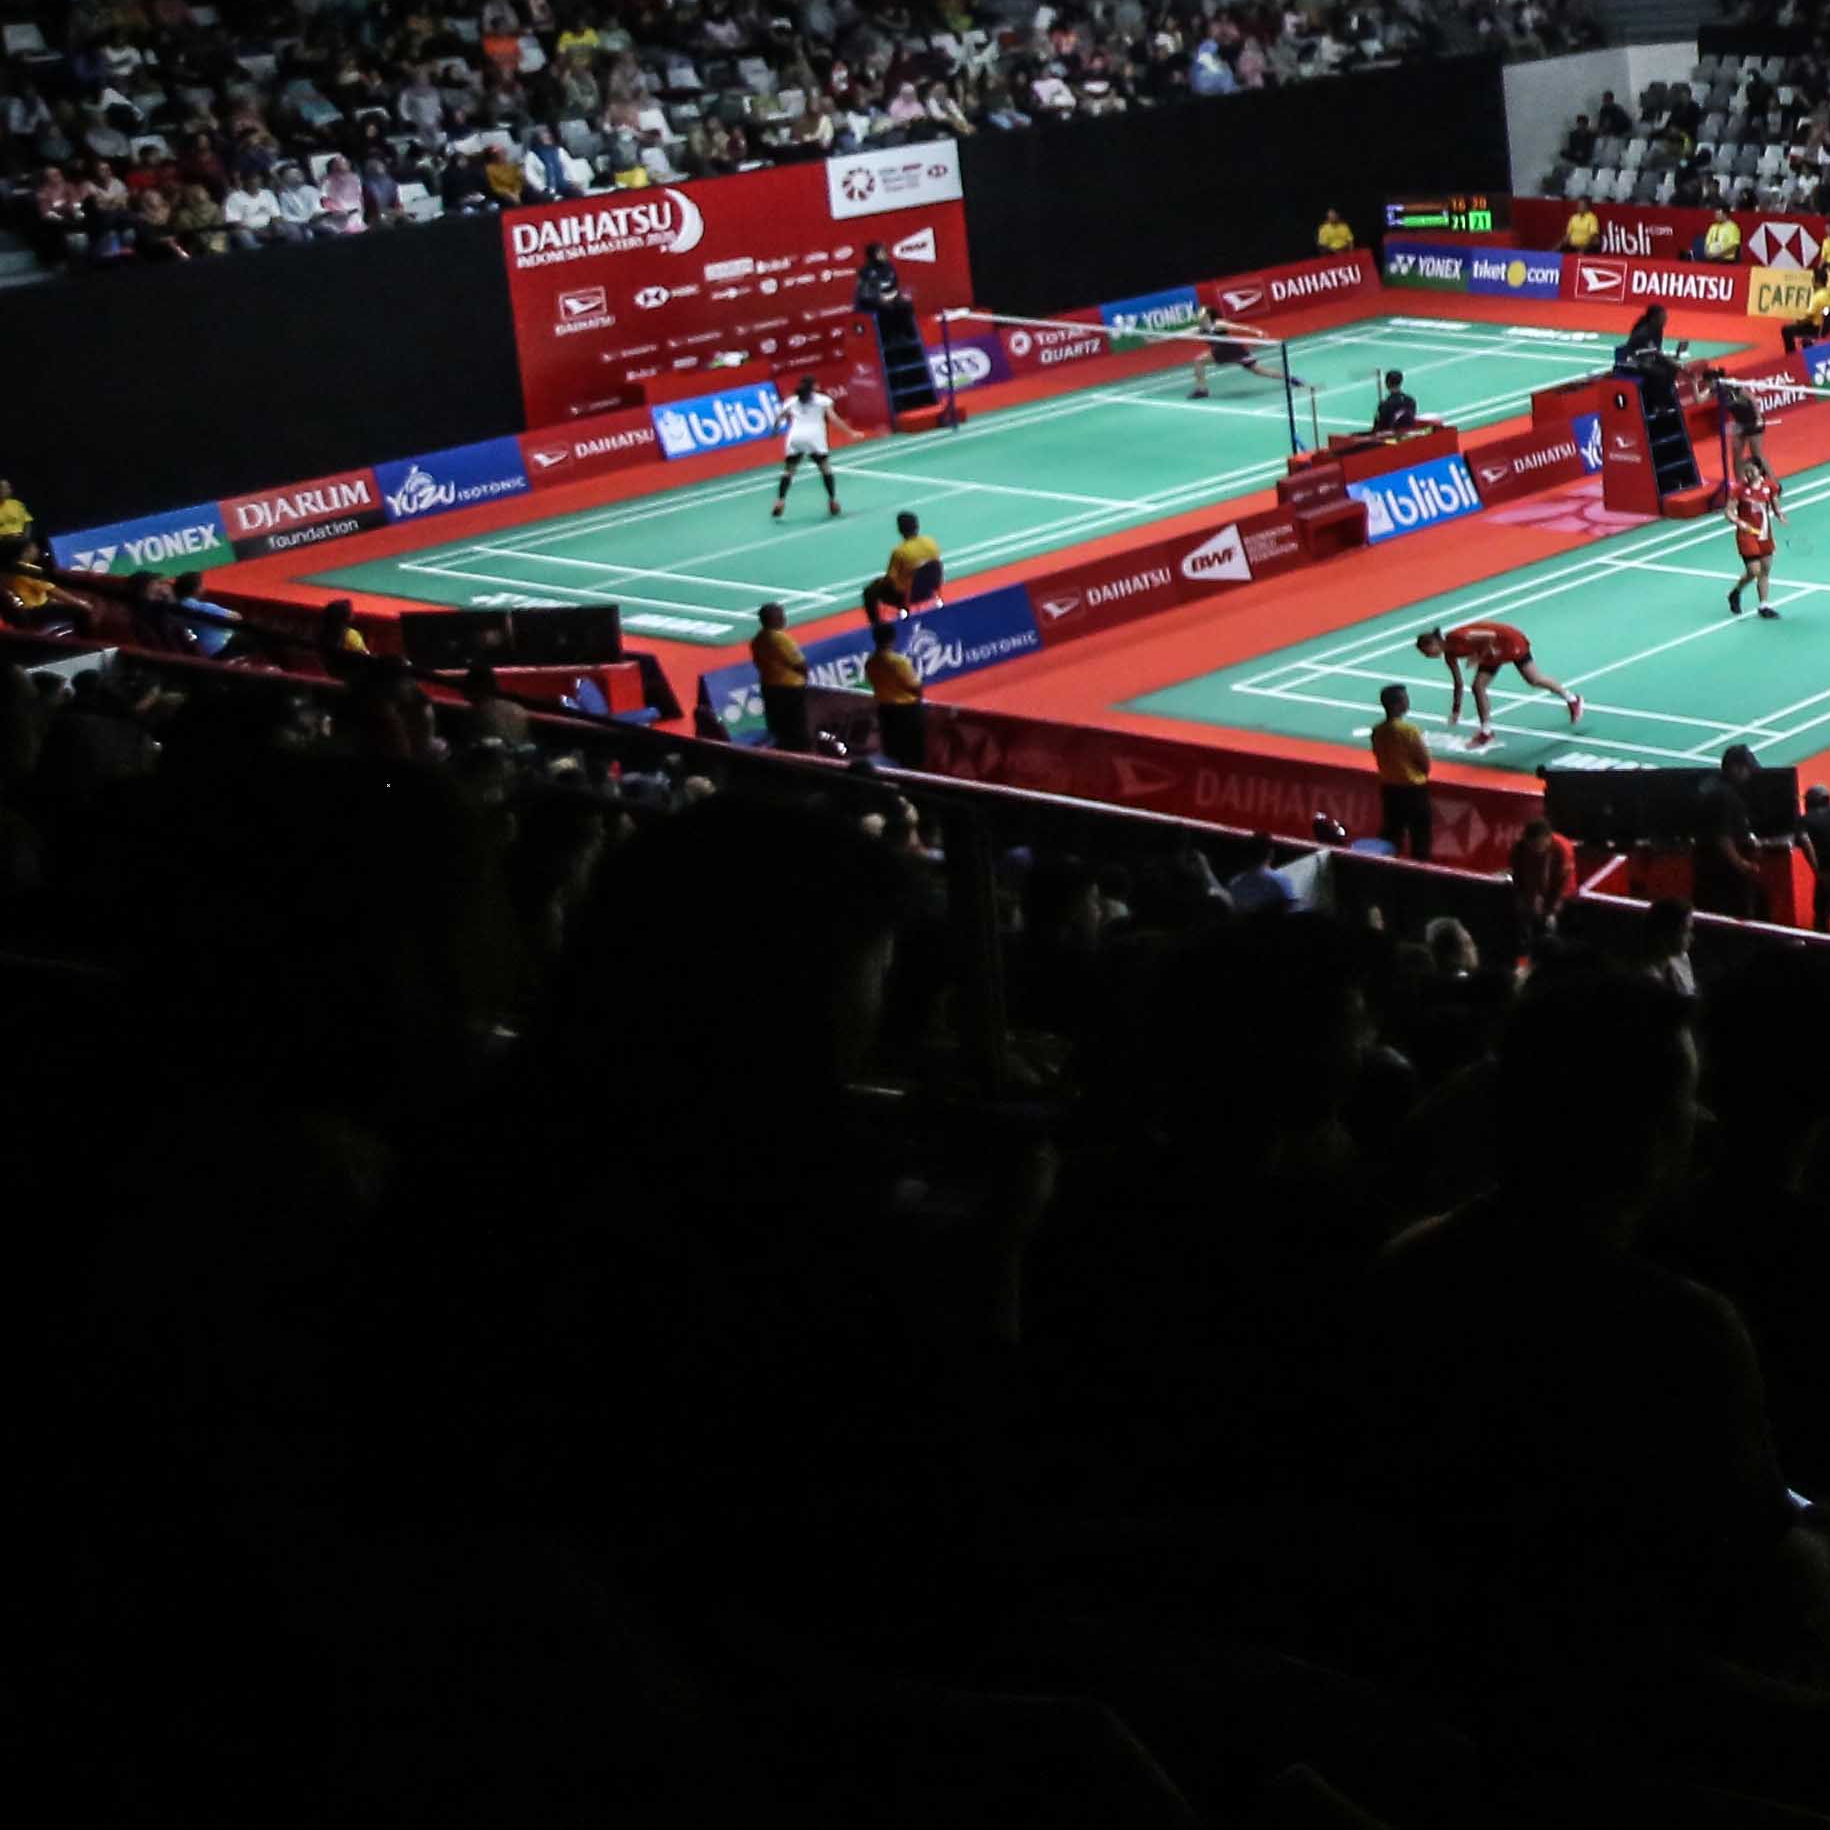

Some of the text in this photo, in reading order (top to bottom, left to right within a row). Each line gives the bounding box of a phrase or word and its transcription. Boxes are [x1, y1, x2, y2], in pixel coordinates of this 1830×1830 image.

[511, 200, 675, 255] DAIHATSU
[516, 245, 586, 269] INDONESIA
[1416, 256, 1463, 281] YONEX
[1270, 265, 1363, 302] DAIHATSU
[1632, 268, 1735, 301] DAIHATSU
[573, 427, 655, 460] DAIHATSU
[1512, 442, 1578, 475] DAIHATSU
[236, 478, 373, 532] DJARUM
[385, 475, 528, 520] YUZU ISOTONIC
[1382, 463, 1481, 522] blibli
[123, 521, 222, 568] YONEX
[267, 517, 361, 552] foundation
[1086, 568, 1171, 608] DAIHATSU
[964, 629, 1040, 663] ISOTONIC
